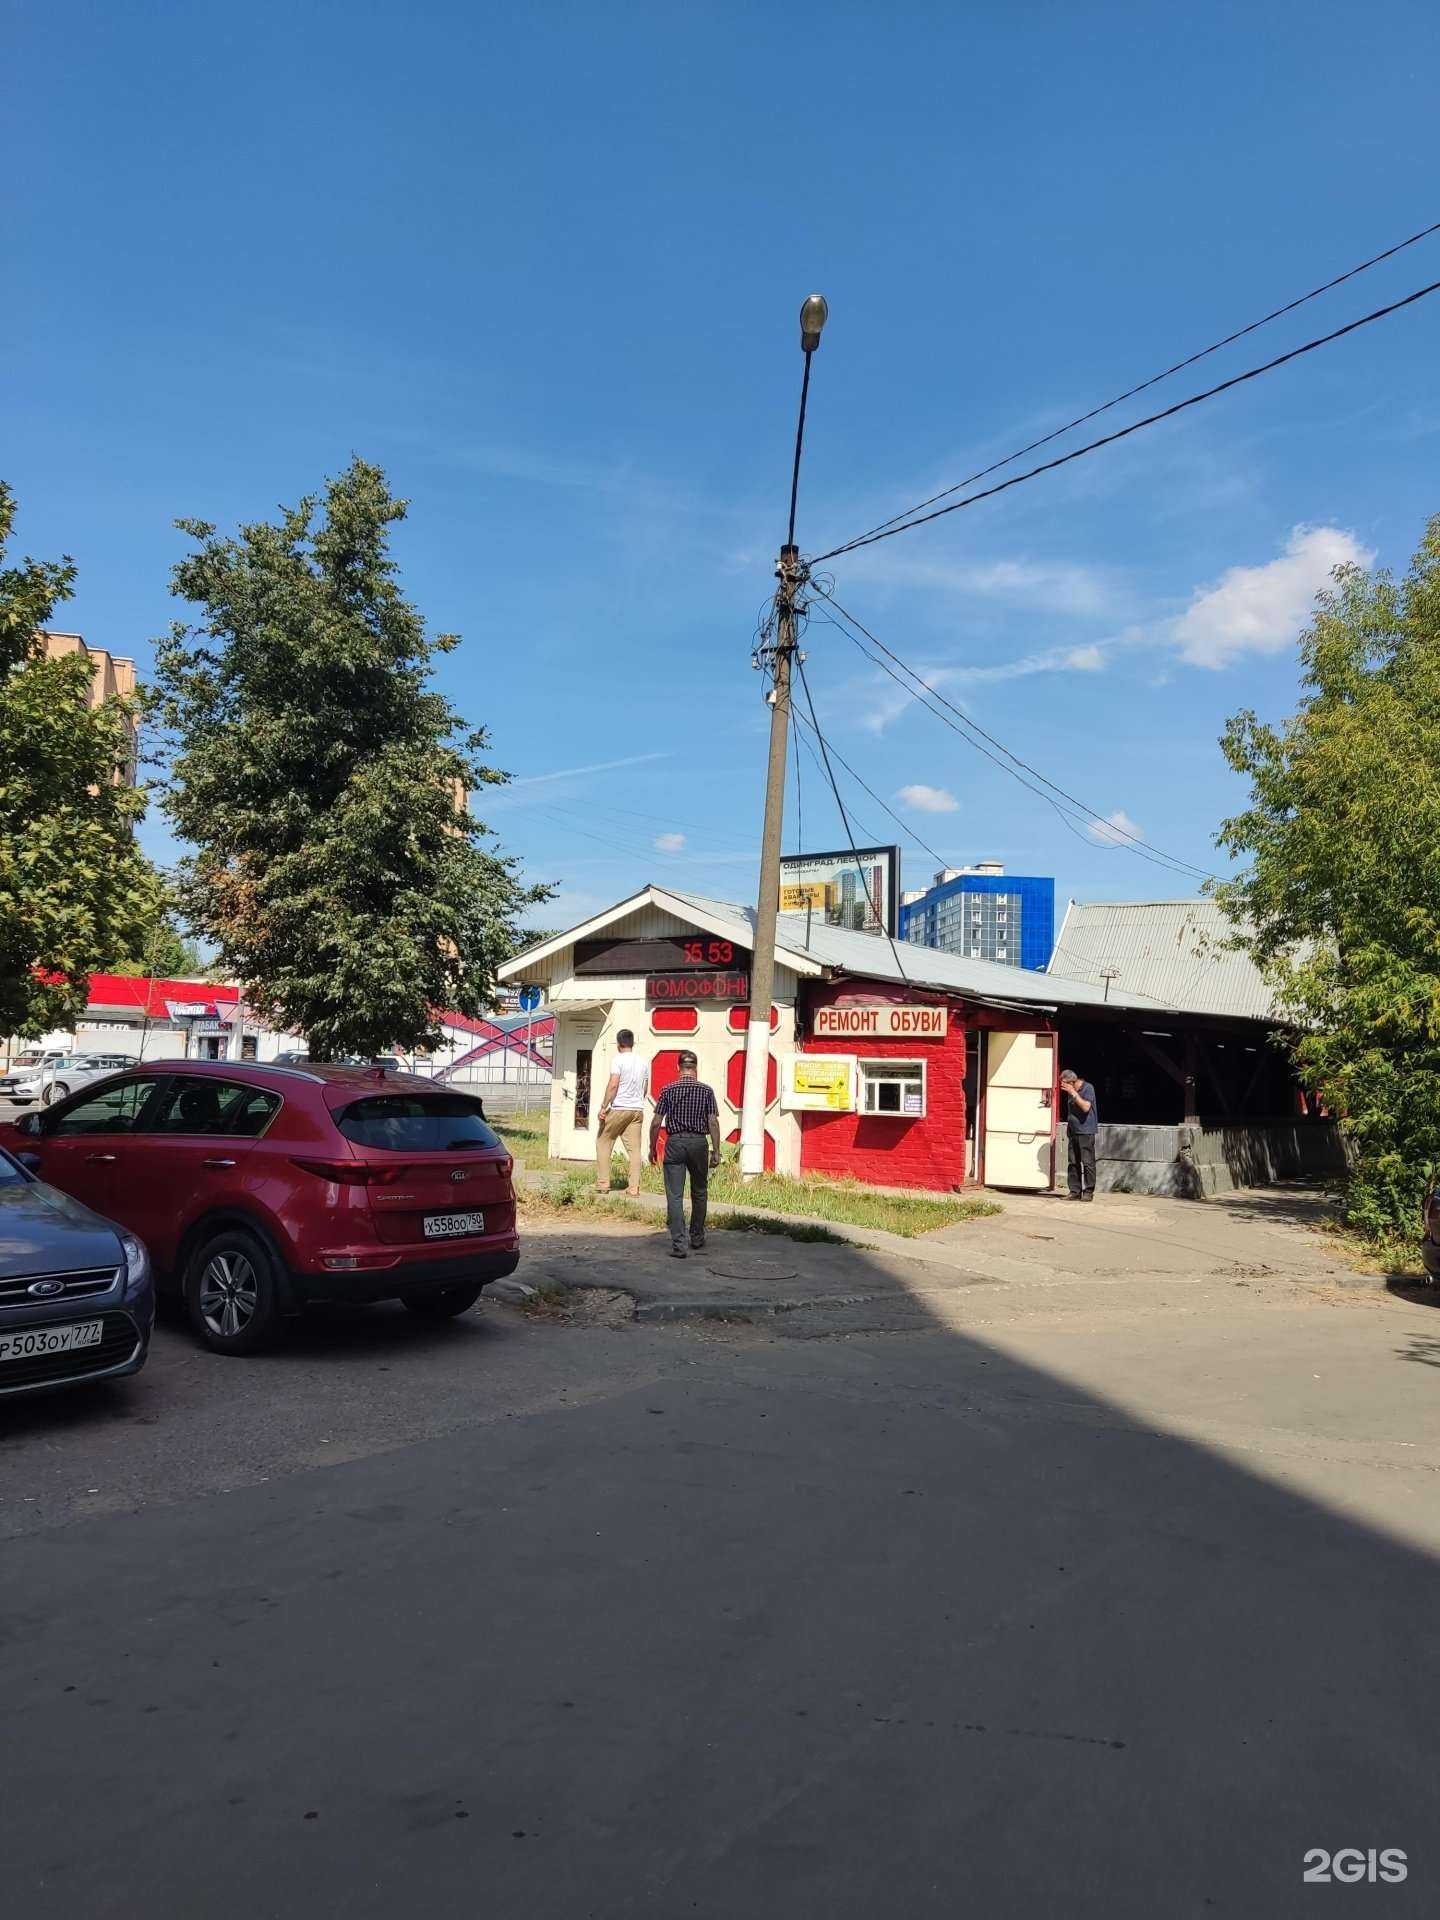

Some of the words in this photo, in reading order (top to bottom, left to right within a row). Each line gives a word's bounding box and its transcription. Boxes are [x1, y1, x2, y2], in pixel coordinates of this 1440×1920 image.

[708, 941, 733, 963] 53
[819, 1011, 880, 1032] РЕМОНТ
[890, 1011, 942, 1032] ОБУВИ
[74, 1324, 99, 1341] 777
